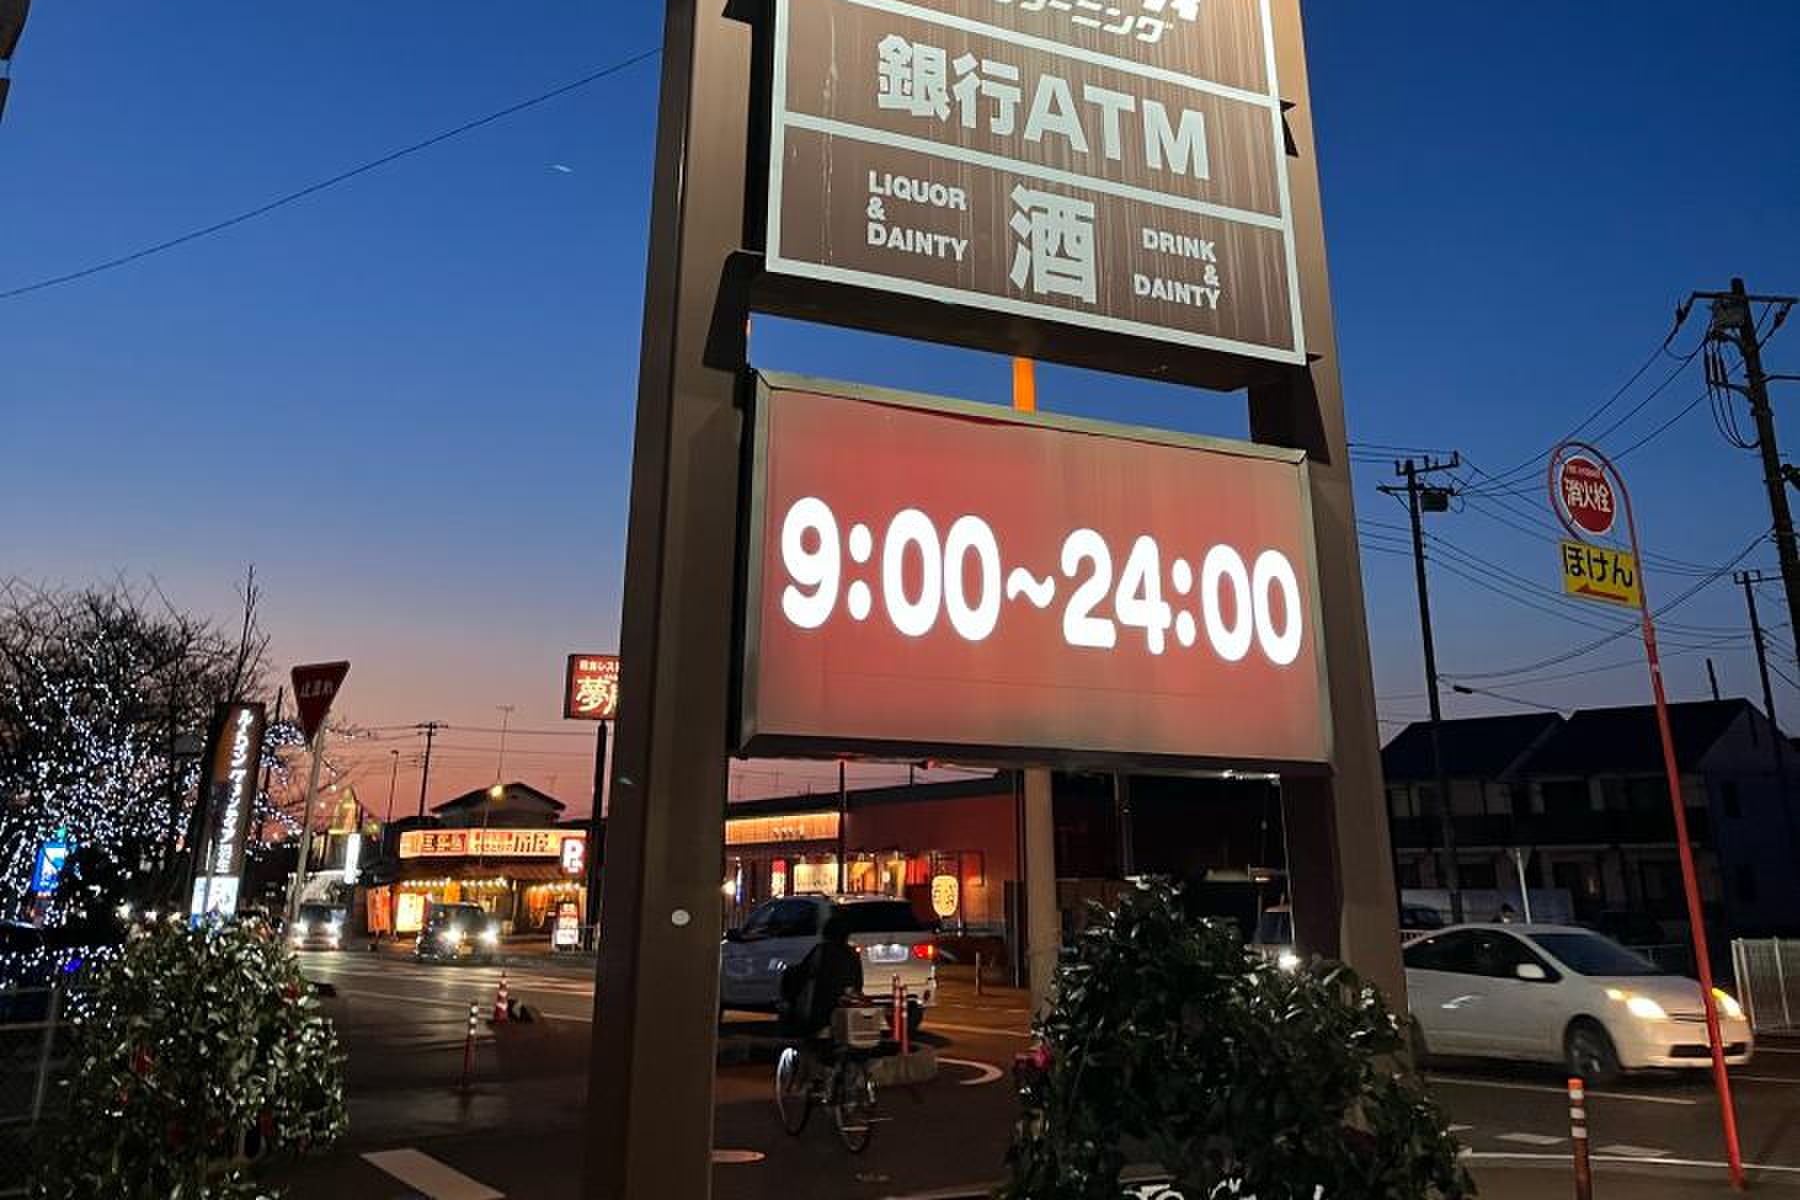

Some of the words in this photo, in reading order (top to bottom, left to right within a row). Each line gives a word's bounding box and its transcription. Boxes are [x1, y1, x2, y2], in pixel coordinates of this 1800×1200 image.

[878, 33, 1209, 180] 銀行ATM
[866, 196, 887, 222] &
[868, 170, 967, 211] LIQUOR
[867, 221, 968, 262] DAINTY
[1008, 183, 1098, 304] 酒
[1142, 227, 1216, 263] DRINK
[1133, 273, 1220, 311] DAINTY
[1203, 264, 1219, 287] &
[1563, 477, 1612, 513] 消火栓
[1562, 544, 1633, 587] ほけん
